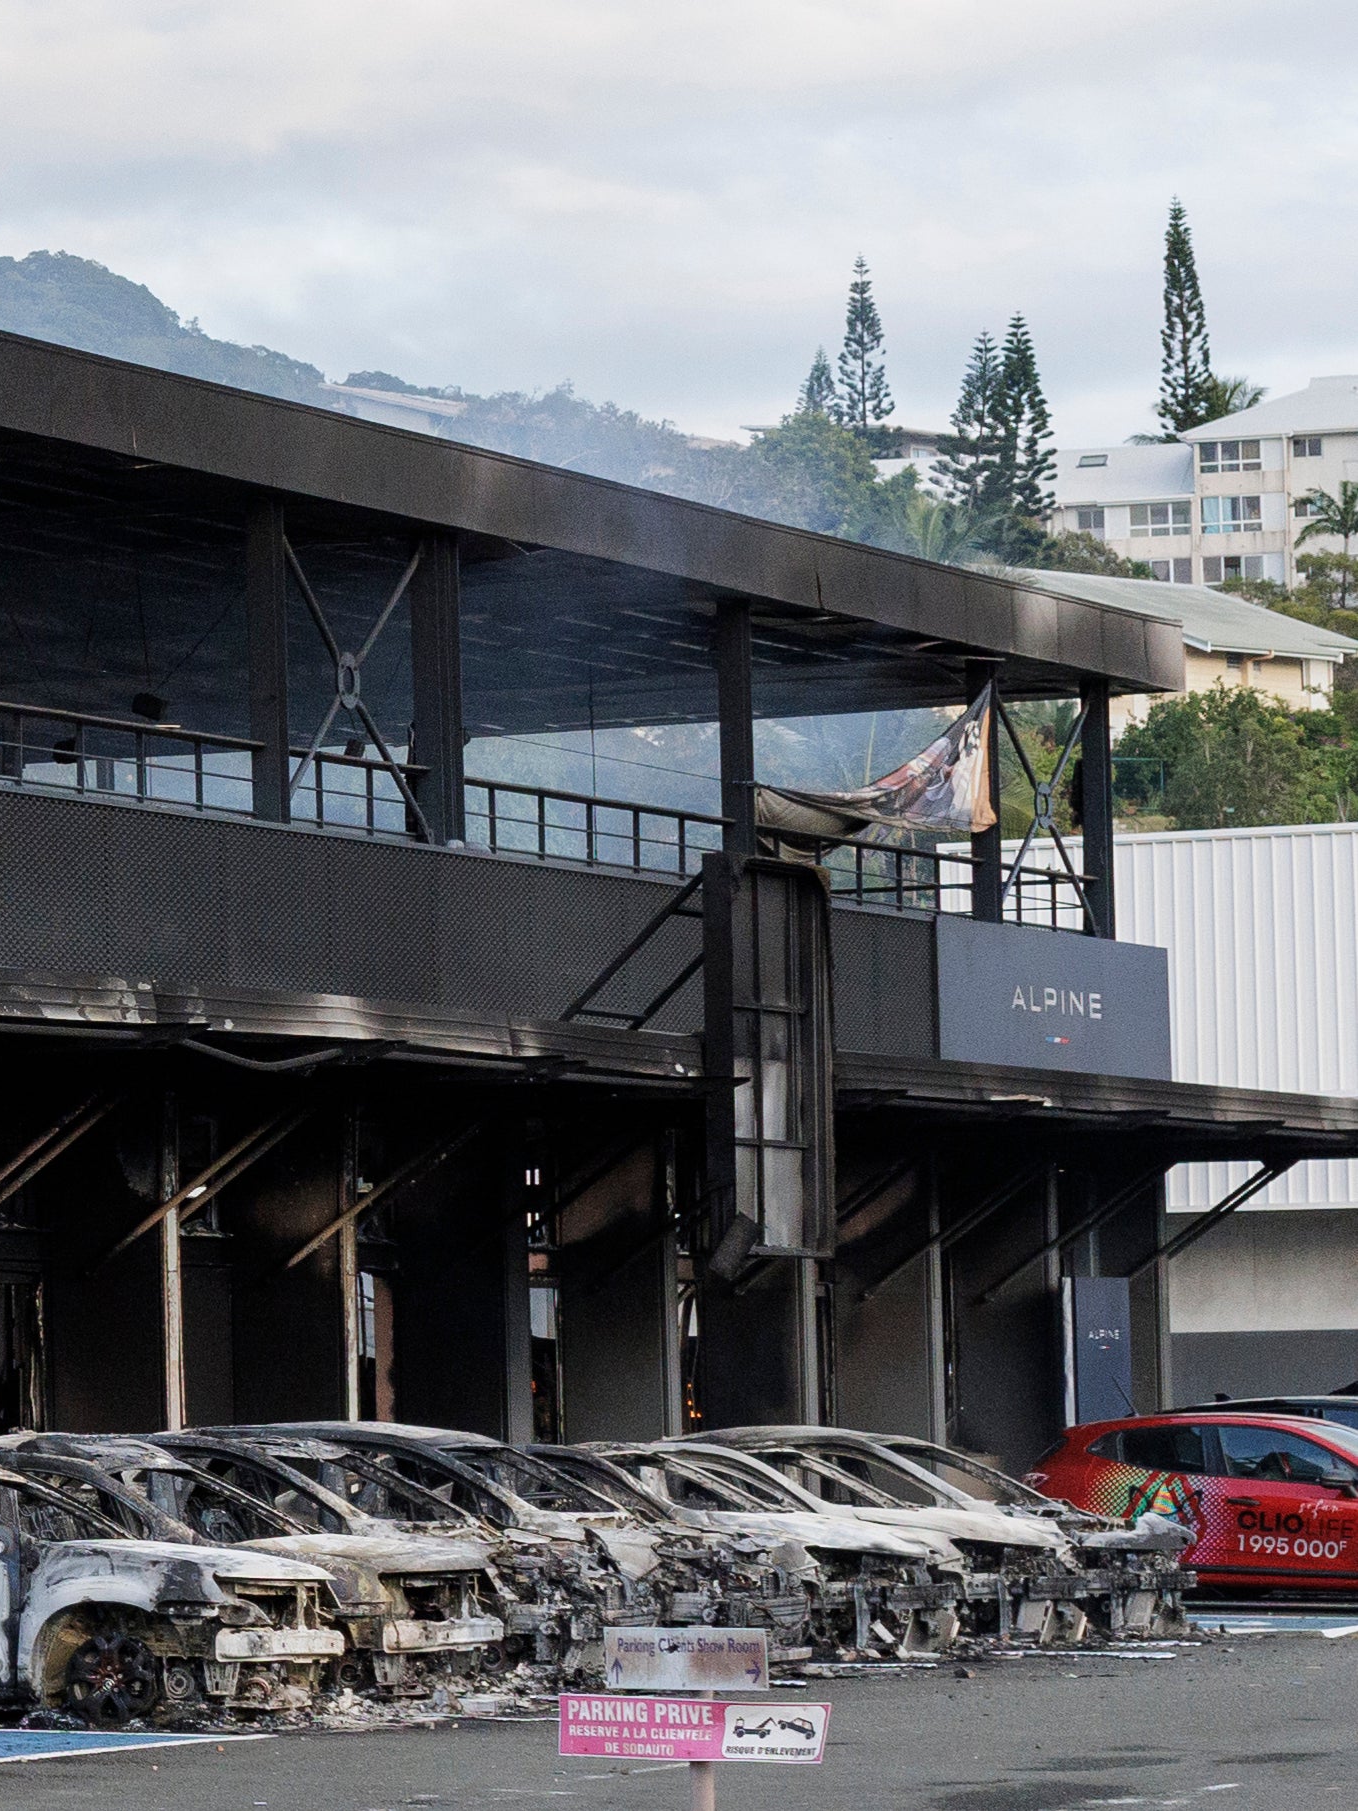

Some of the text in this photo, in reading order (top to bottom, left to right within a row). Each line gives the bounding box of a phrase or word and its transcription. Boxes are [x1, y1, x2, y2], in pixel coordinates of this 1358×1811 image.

[1011, 985, 1102, 1020] ALPINE
[1088, 1328, 1120, 1340] ALPINE
[1237, 1510, 1304, 1534] CLIO
[617, 1637, 655, 1657] Parking
[697, 1637, 725, 1653] Show
[727, 1637, 760, 1653] Room
[568, 1699, 714, 1725] PARKING PRIVE
[568, 1724, 712, 1741] RESERVE A LA CLIENTELE
[604, 1742, 675, 1756] DE SODAUTO
[725, 1745, 755, 1755] RISQUE
